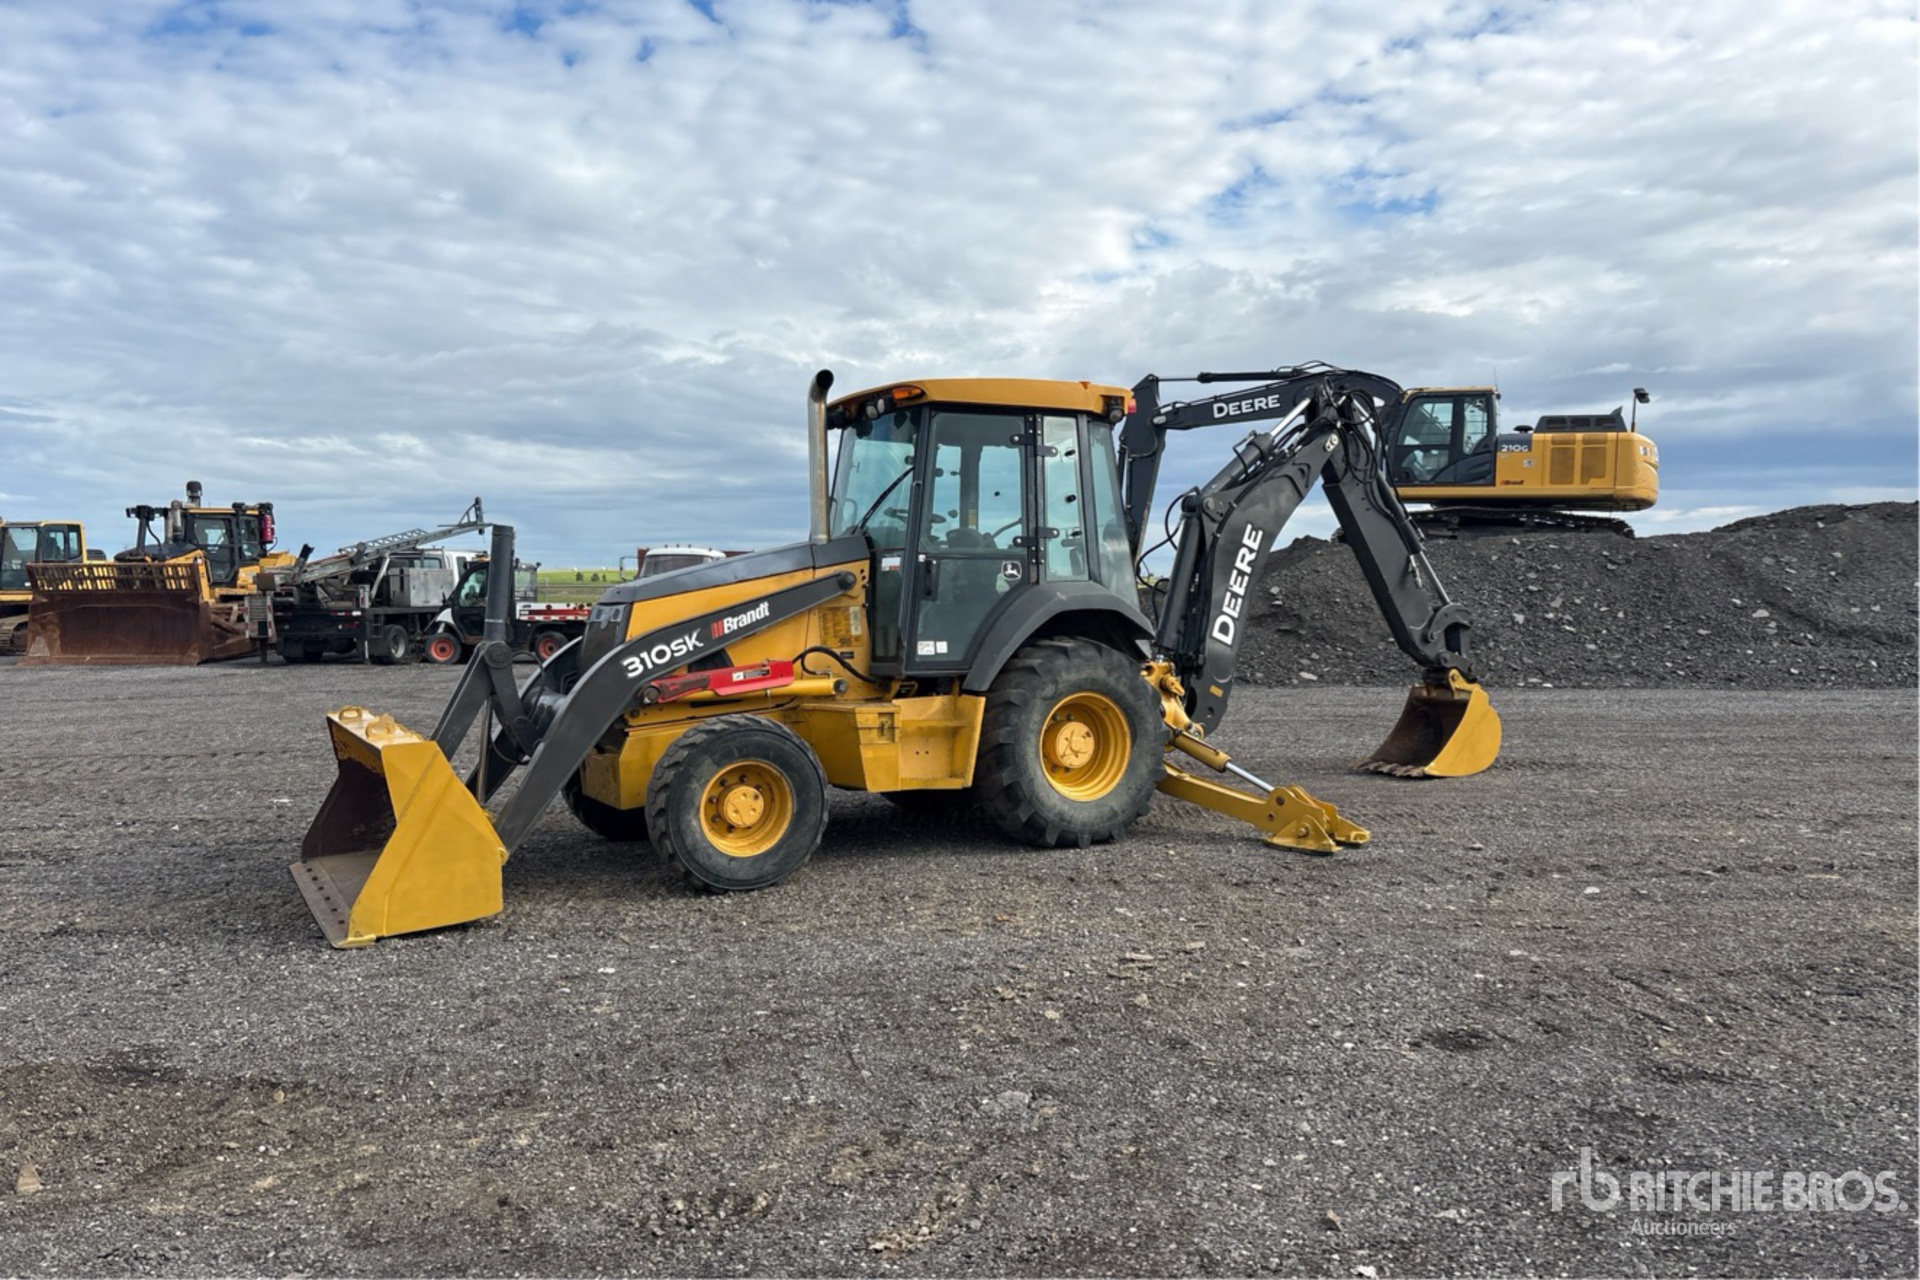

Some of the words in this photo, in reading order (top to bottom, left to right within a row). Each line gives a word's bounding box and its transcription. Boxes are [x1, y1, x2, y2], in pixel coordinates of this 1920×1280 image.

[1213, 394, 1280, 419] DEERE
[1501, 444, 1529, 452] 210G
[1211, 523, 1263, 646] DEERE
[722, 601, 770, 634] Brandt
[621, 629, 704, 678] 310SK
